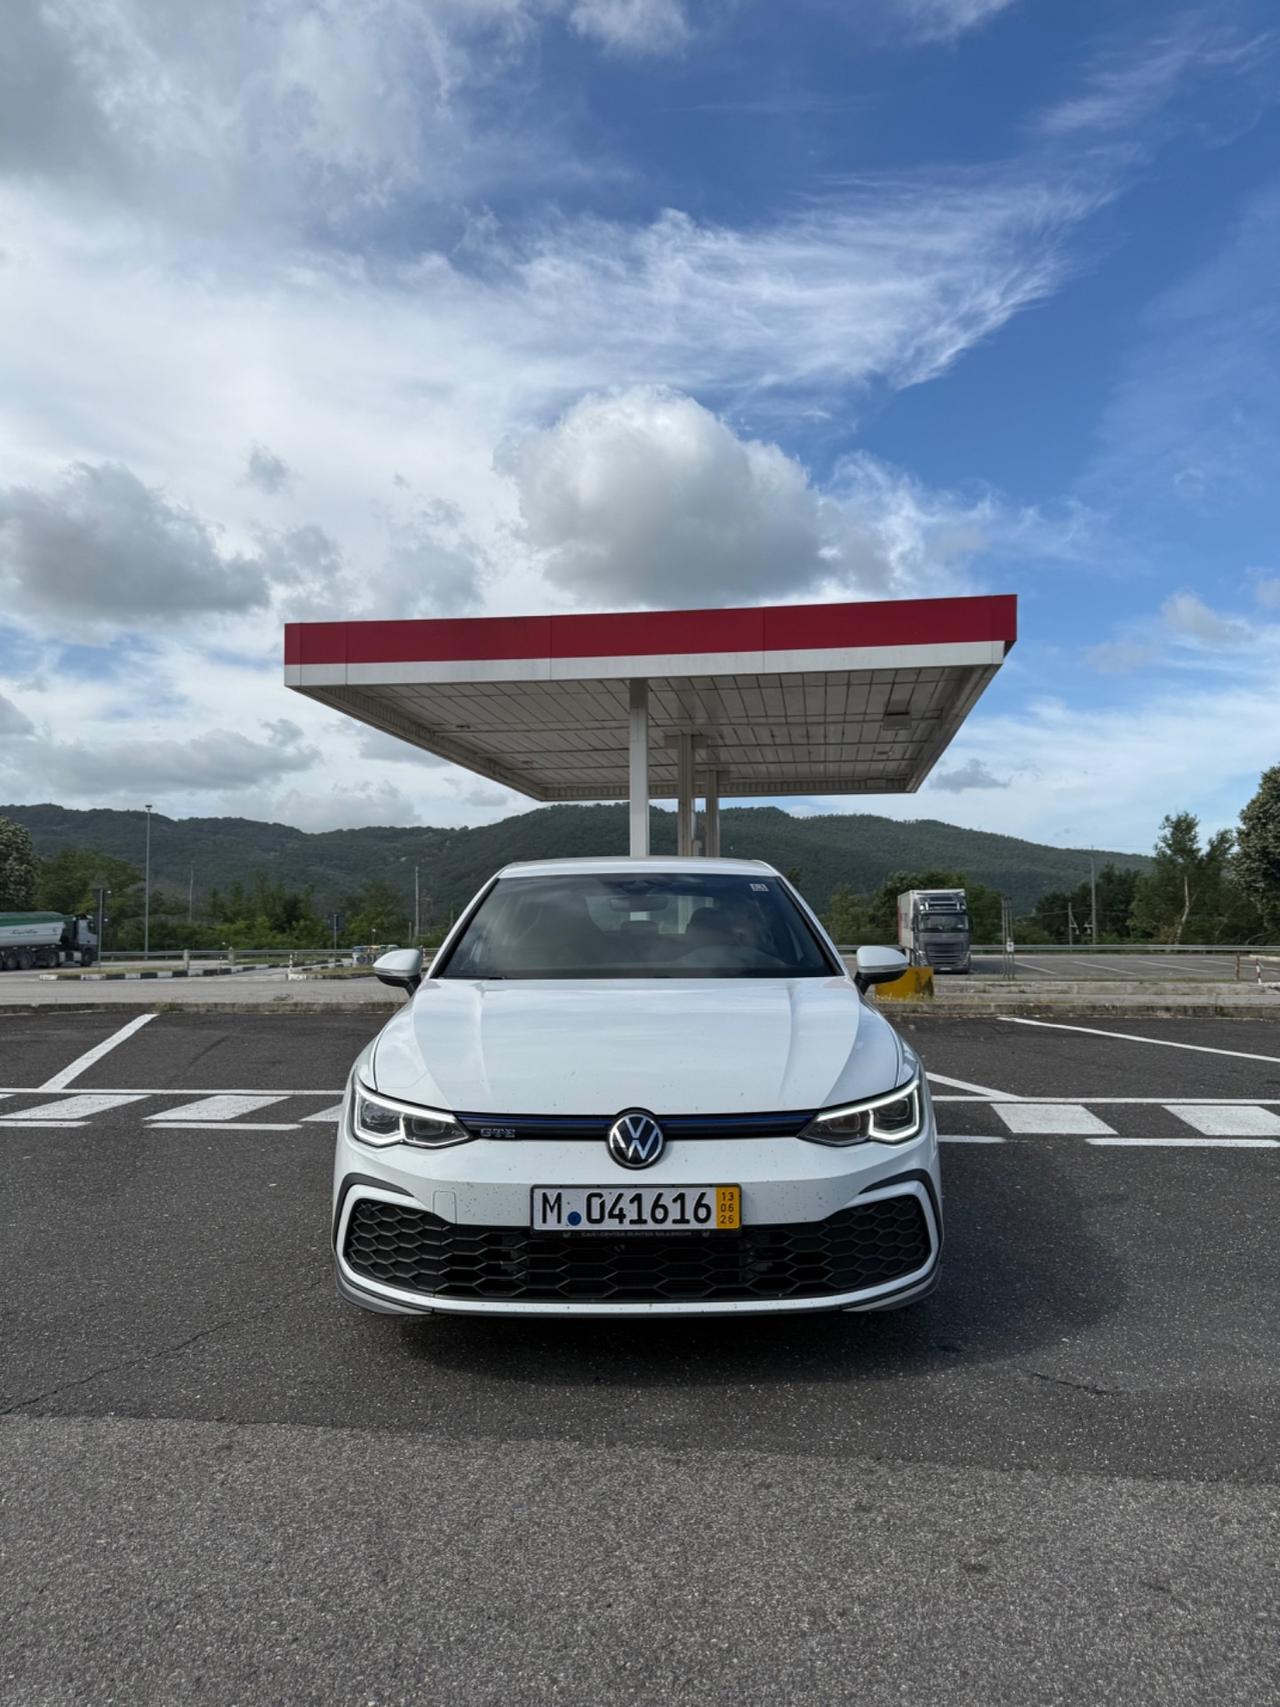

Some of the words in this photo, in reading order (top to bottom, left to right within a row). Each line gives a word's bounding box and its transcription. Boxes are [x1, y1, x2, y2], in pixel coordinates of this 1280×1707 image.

[480, 1127, 516, 1138] GTE
[721, 1191, 735, 1201] 13
[541, 1192, 563, 1224] M
[585, 1191, 712, 1225] 041616
[720, 1203, 735, 1213] 06
